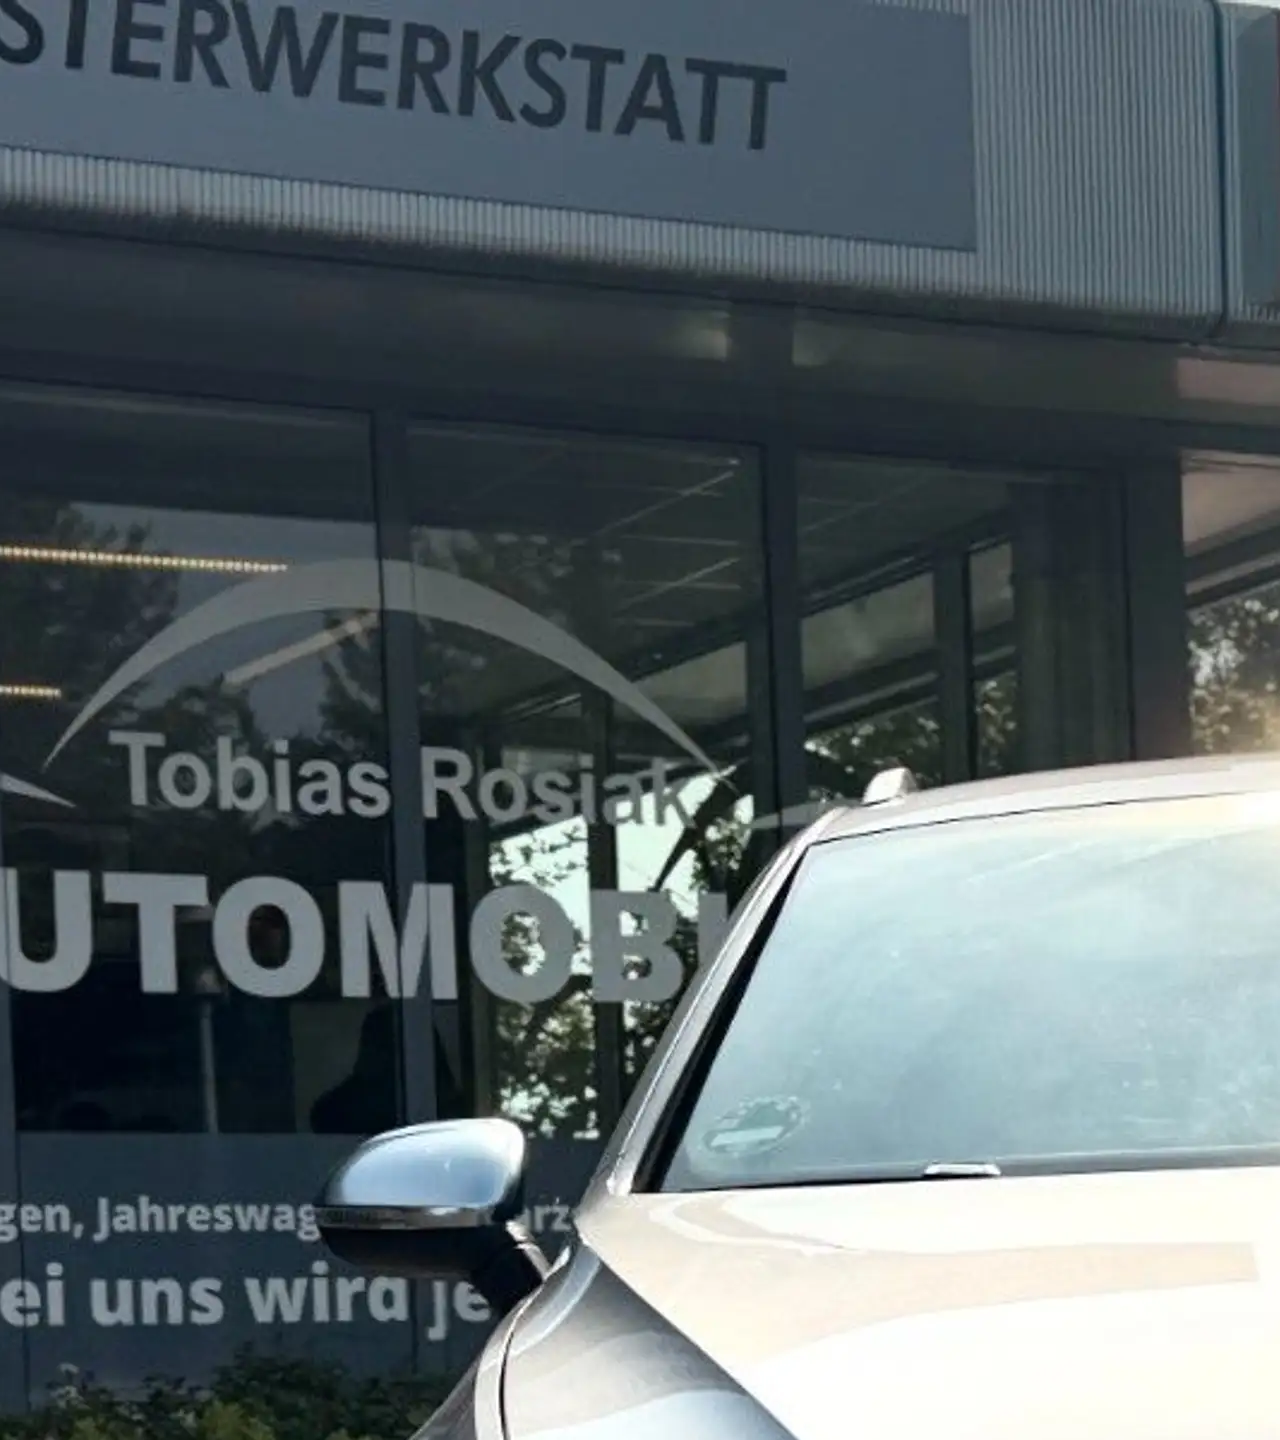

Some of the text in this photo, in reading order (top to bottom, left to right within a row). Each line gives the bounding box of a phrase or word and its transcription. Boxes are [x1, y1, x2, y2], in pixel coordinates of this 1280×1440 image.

[109, 730, 695, 827] Tobias Rosiak
[90, 1277, 224, 1327] uns
